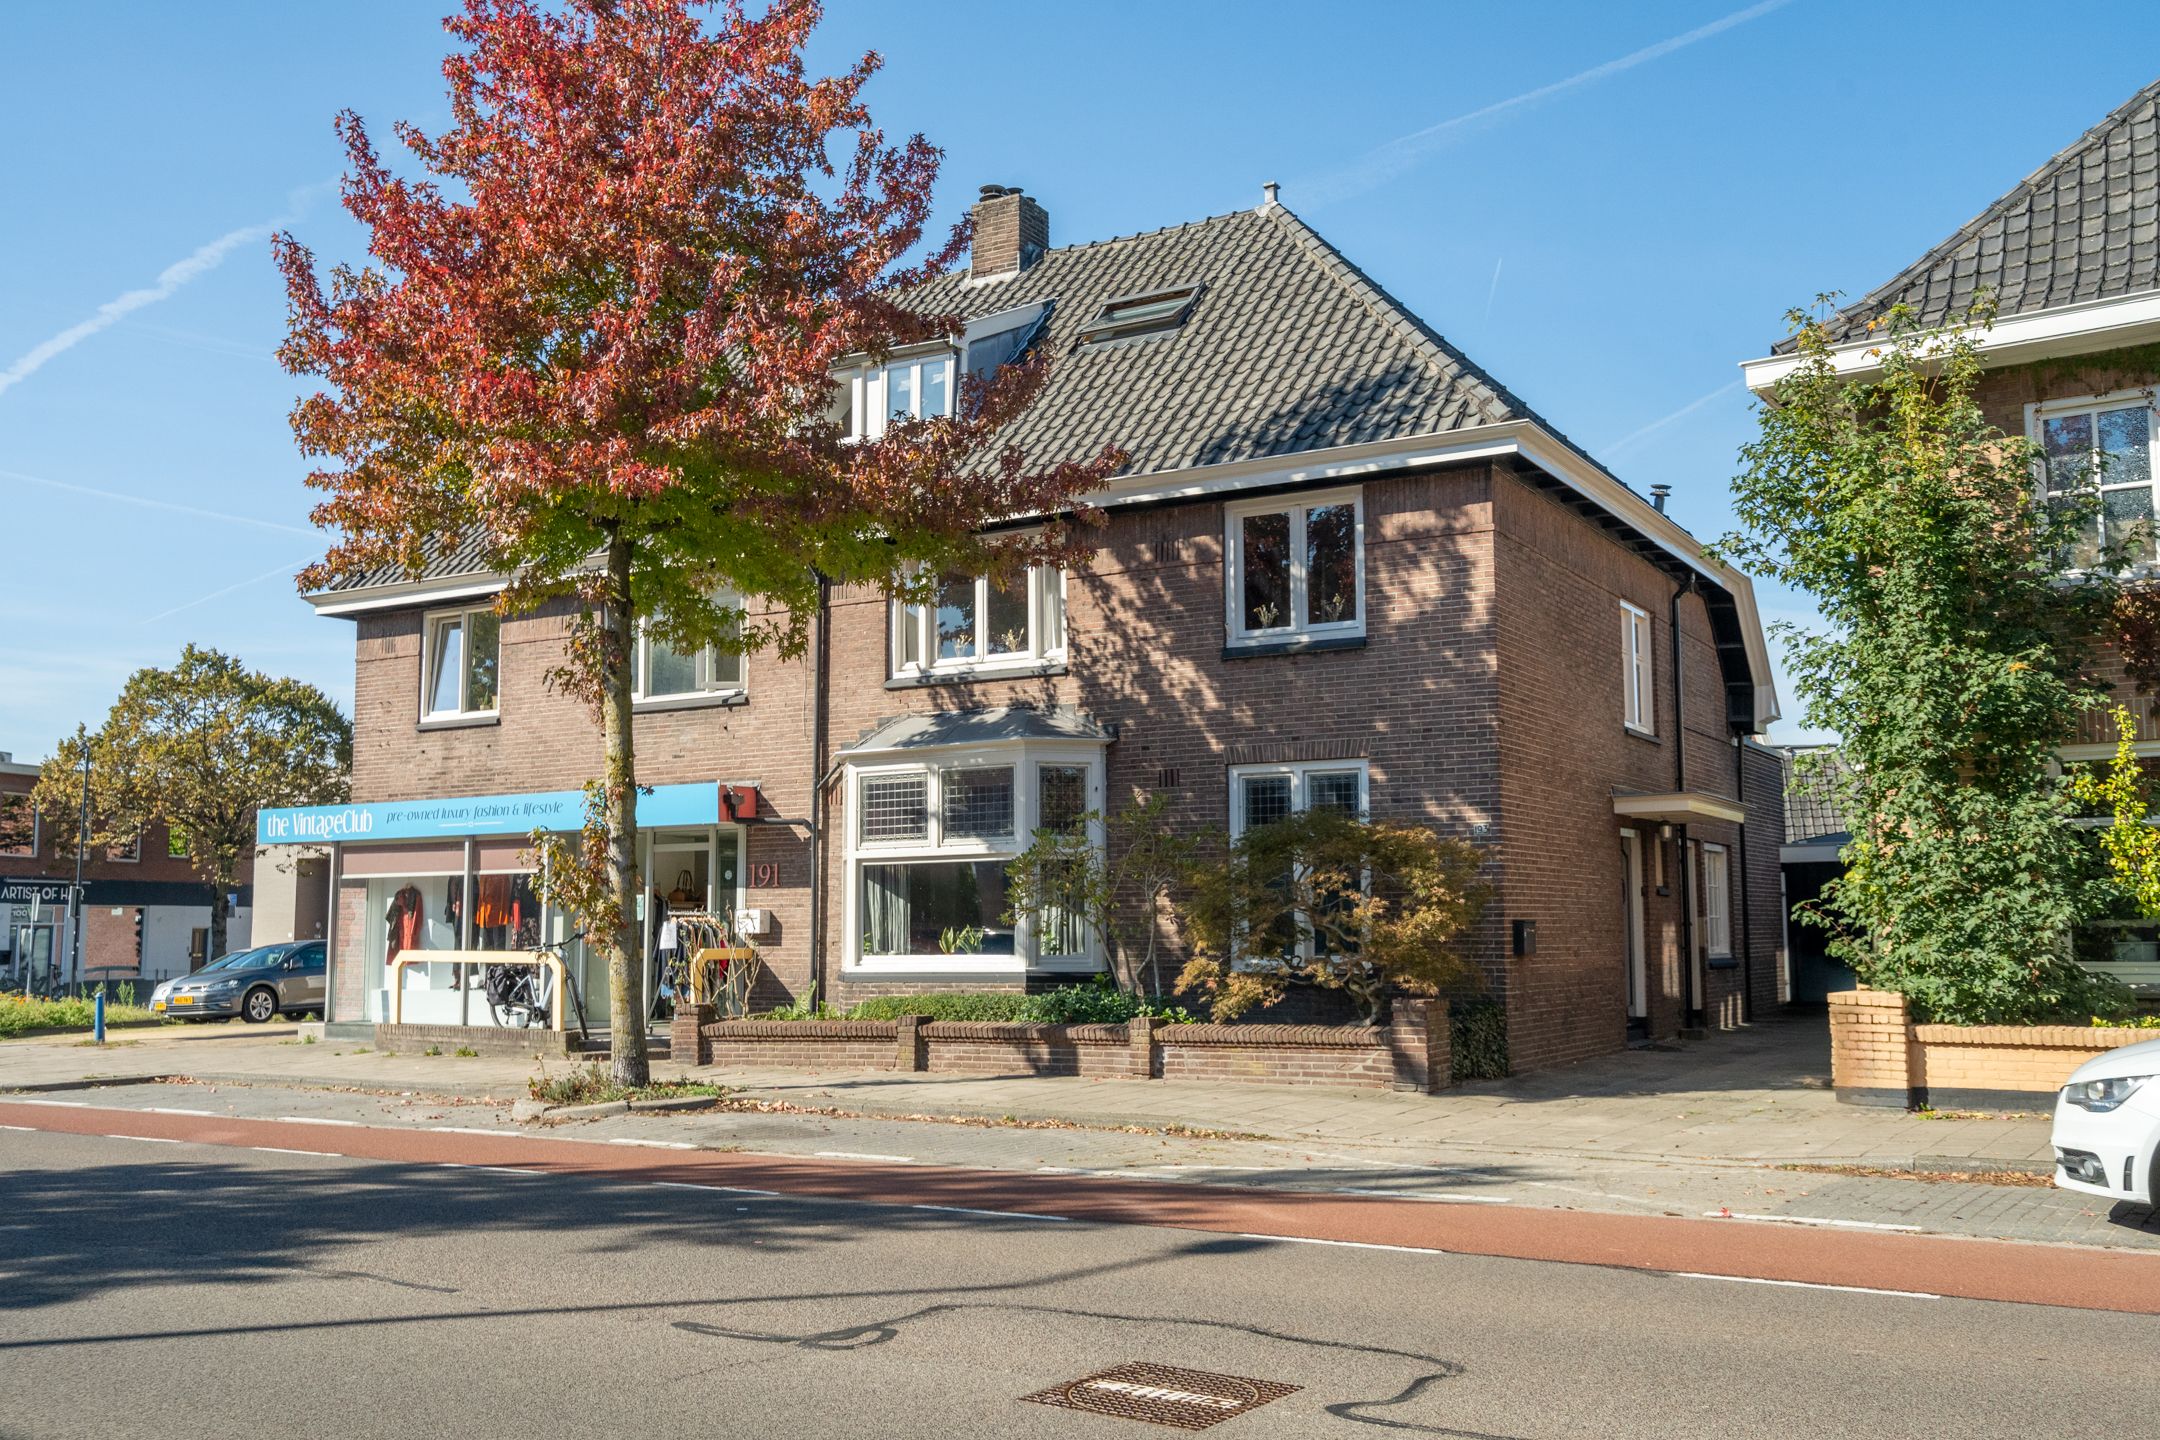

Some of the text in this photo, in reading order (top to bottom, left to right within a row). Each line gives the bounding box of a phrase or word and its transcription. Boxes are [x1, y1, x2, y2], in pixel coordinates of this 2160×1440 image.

[267, 808, 373, 838] the VintageClub
[386, 800, 565, 824] pre-owned luxury fashion & lifestyle
[1474, 824, 1489, 834] 193
[749, 862, 780, 888] 191
[1, 886, 40, 899] ARTIST
[42, 887, 58, 900] OF
